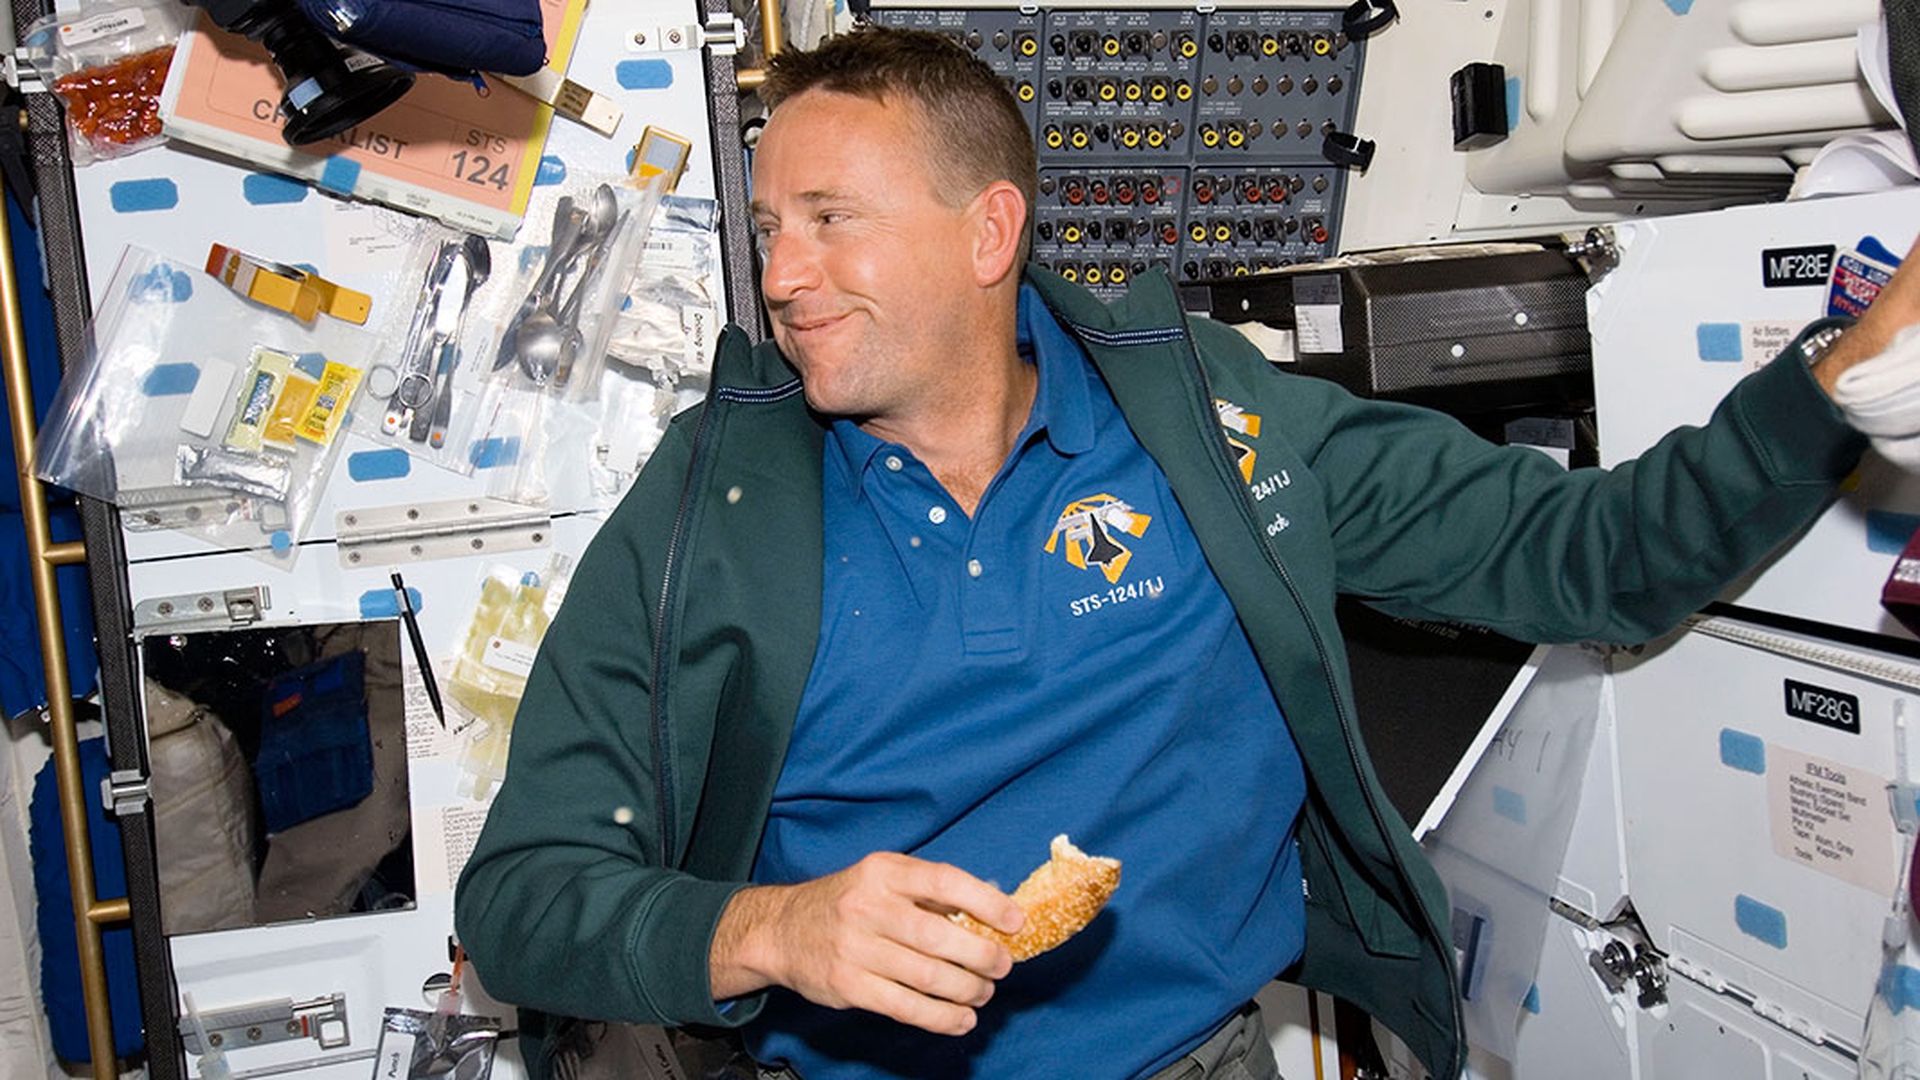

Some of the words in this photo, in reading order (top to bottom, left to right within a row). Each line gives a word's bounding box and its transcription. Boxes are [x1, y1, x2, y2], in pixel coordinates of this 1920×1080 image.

[465, 128, 507, 154] STS
[452, 150, 509, 190] 124
[1769, 253, 1829, 279] MF28E
[1069, 575, 1165, 616] STS-124/1J
[1790, 688, 1854, 724] MF28G
